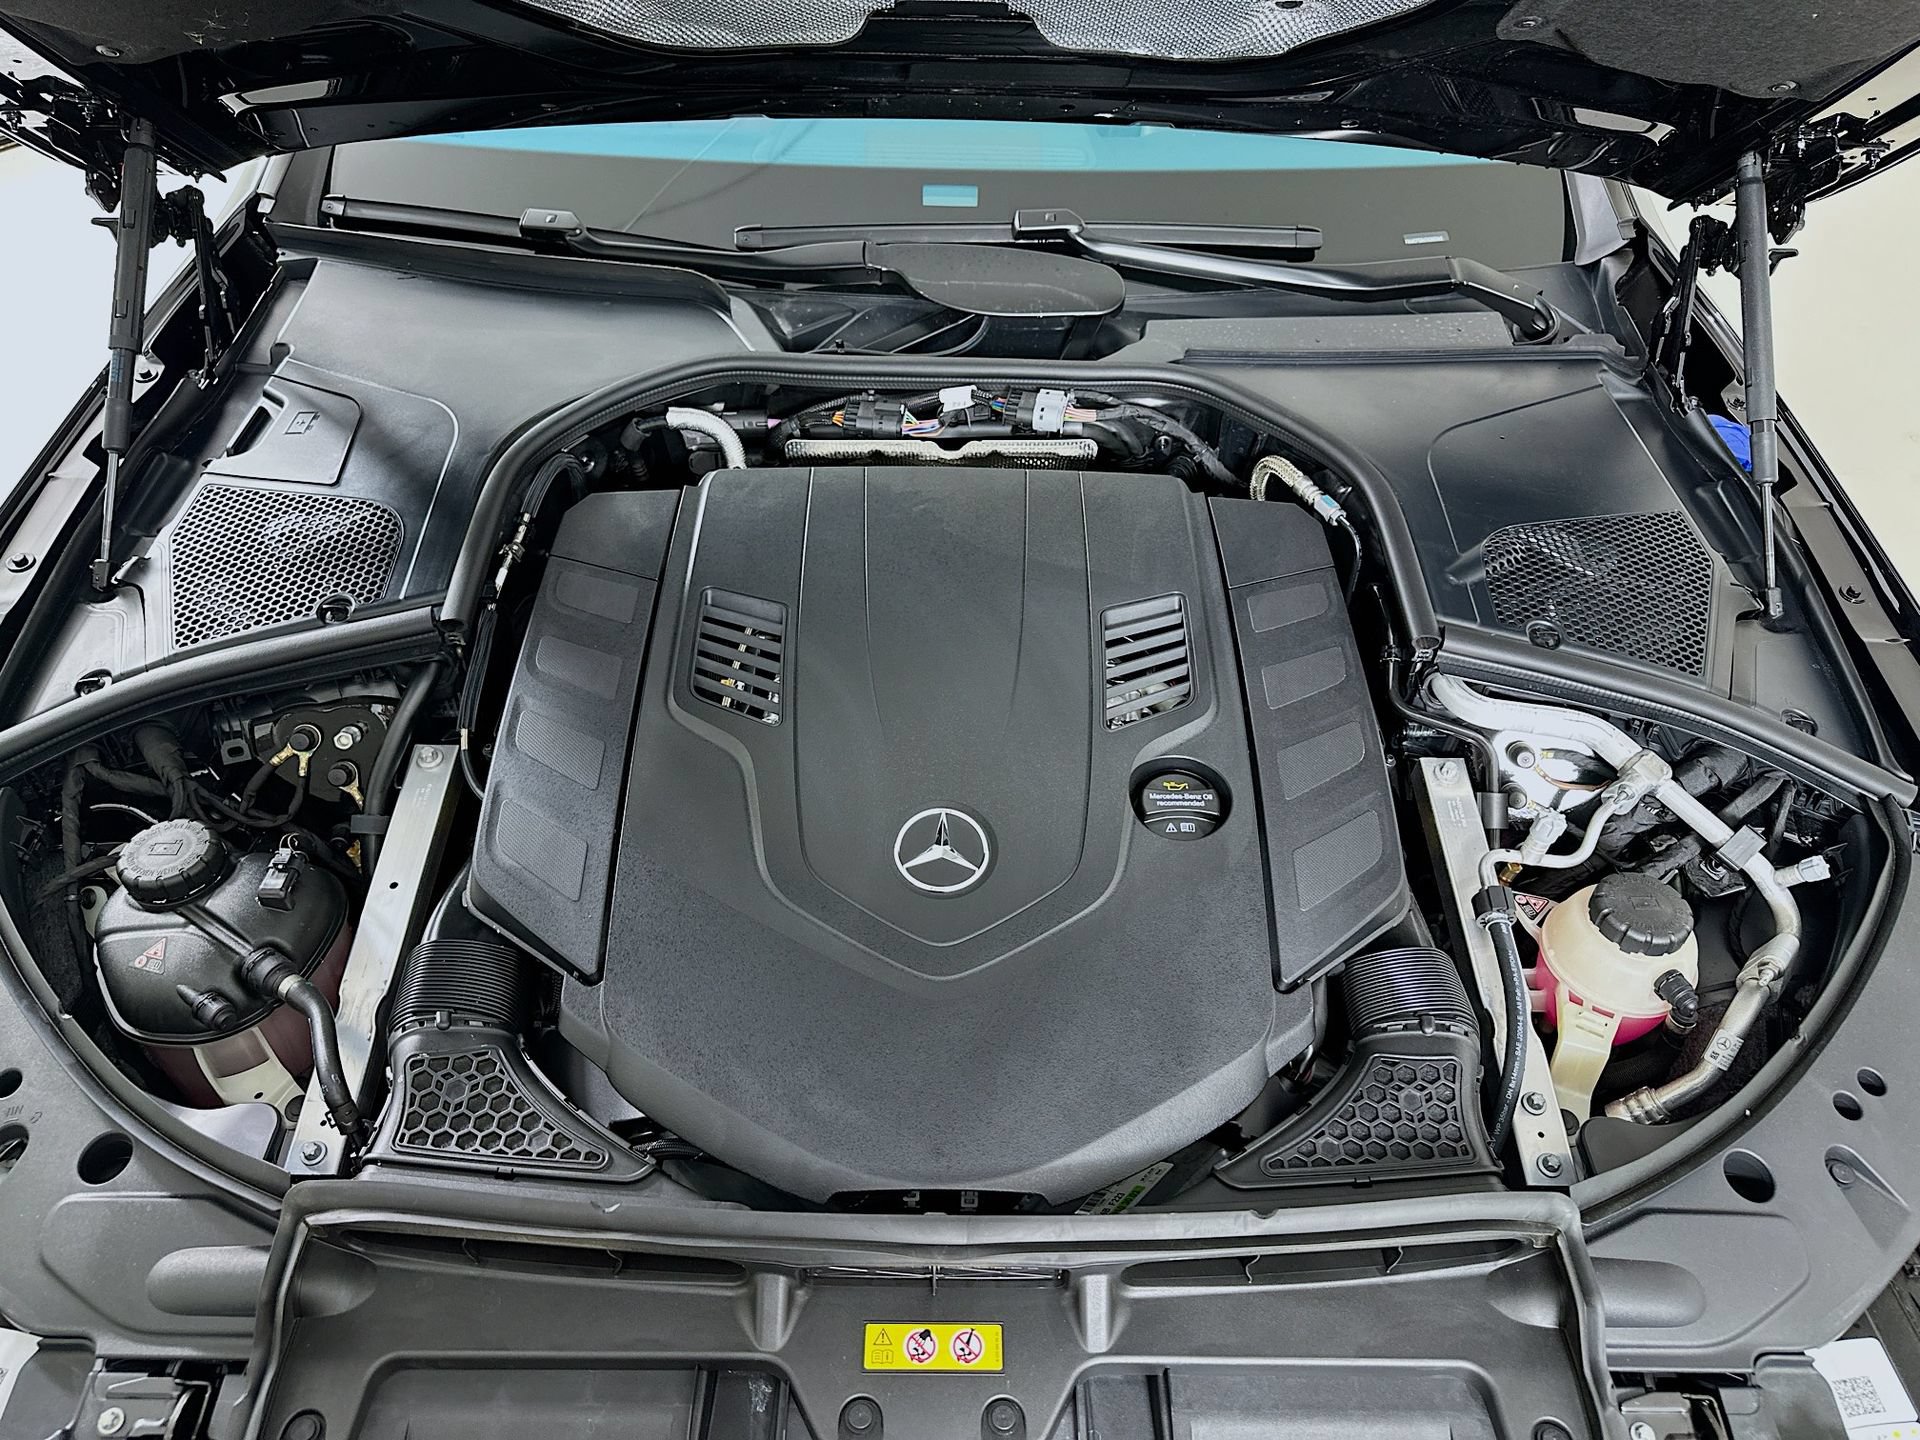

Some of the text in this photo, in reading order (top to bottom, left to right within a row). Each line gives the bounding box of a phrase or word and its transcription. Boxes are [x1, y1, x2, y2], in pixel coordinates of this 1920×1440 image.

[1149, 792, 1213, 800] Mercedes-Benz Oil
[1509, 1061, 1520, 1088] 8x14mm
[1505, 1087, 1514, 1100] DN
[1498, 1103, 1508, 1123] 35bar
[1493, 1122, 1501, 1135] WP
